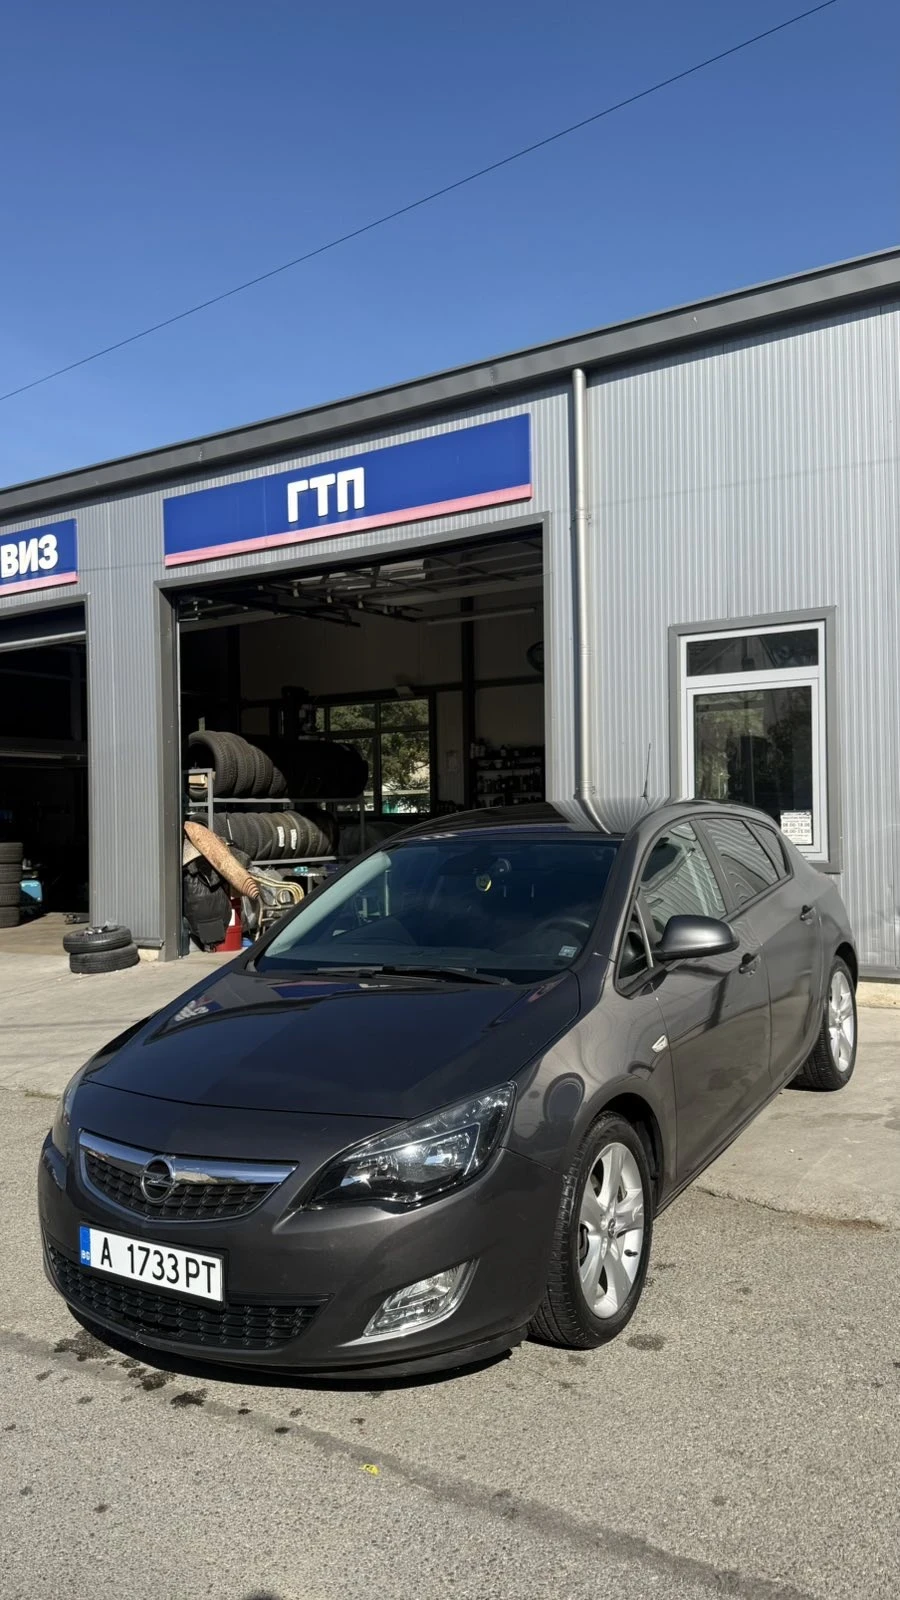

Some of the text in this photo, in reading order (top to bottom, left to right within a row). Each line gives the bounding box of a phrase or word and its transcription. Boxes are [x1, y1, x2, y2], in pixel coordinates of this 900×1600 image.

[287, 467, 365, 523] ГТП
[0, 534, 59, 579] ВИЗ
[81, 1249, 91, 1261] BG
[100, 1236, 113, 1268] A
